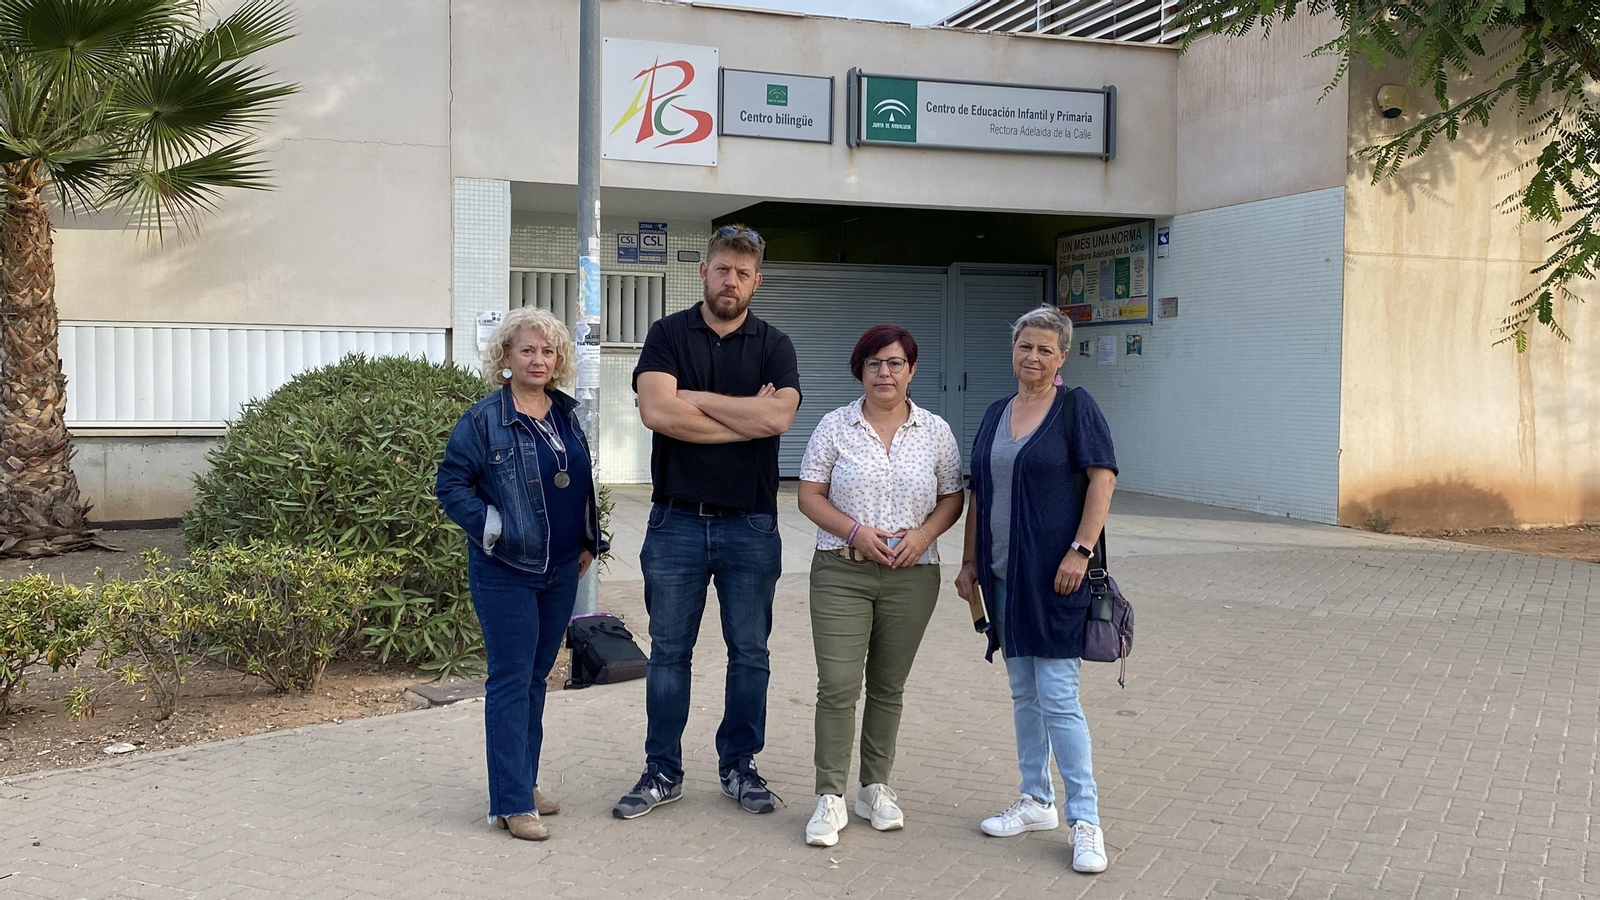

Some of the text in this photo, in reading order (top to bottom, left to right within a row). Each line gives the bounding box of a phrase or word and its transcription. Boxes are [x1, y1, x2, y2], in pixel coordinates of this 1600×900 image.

[740, 110, 814, 129] Centro bilingüe
[926, 101, 1093, 123] Centro de Educación Infantil y Primaria
[990, 123, 1092, 140] Rectora Adelaida de la Calle
[620, 235, 636, 244] CSL
[643, 235, 664, 247] CSL
[1062, 228, 1142, 253] UN MES UNA NORMA
[1060, 254, 1072, 264] CEIP
[1072, 252, 1092, 262] Rectora
[1092, 249, 1115, 260] Adelaida
[1115, 246, 1124, 256] de
[1130, 243, 1146, 253] Calle
